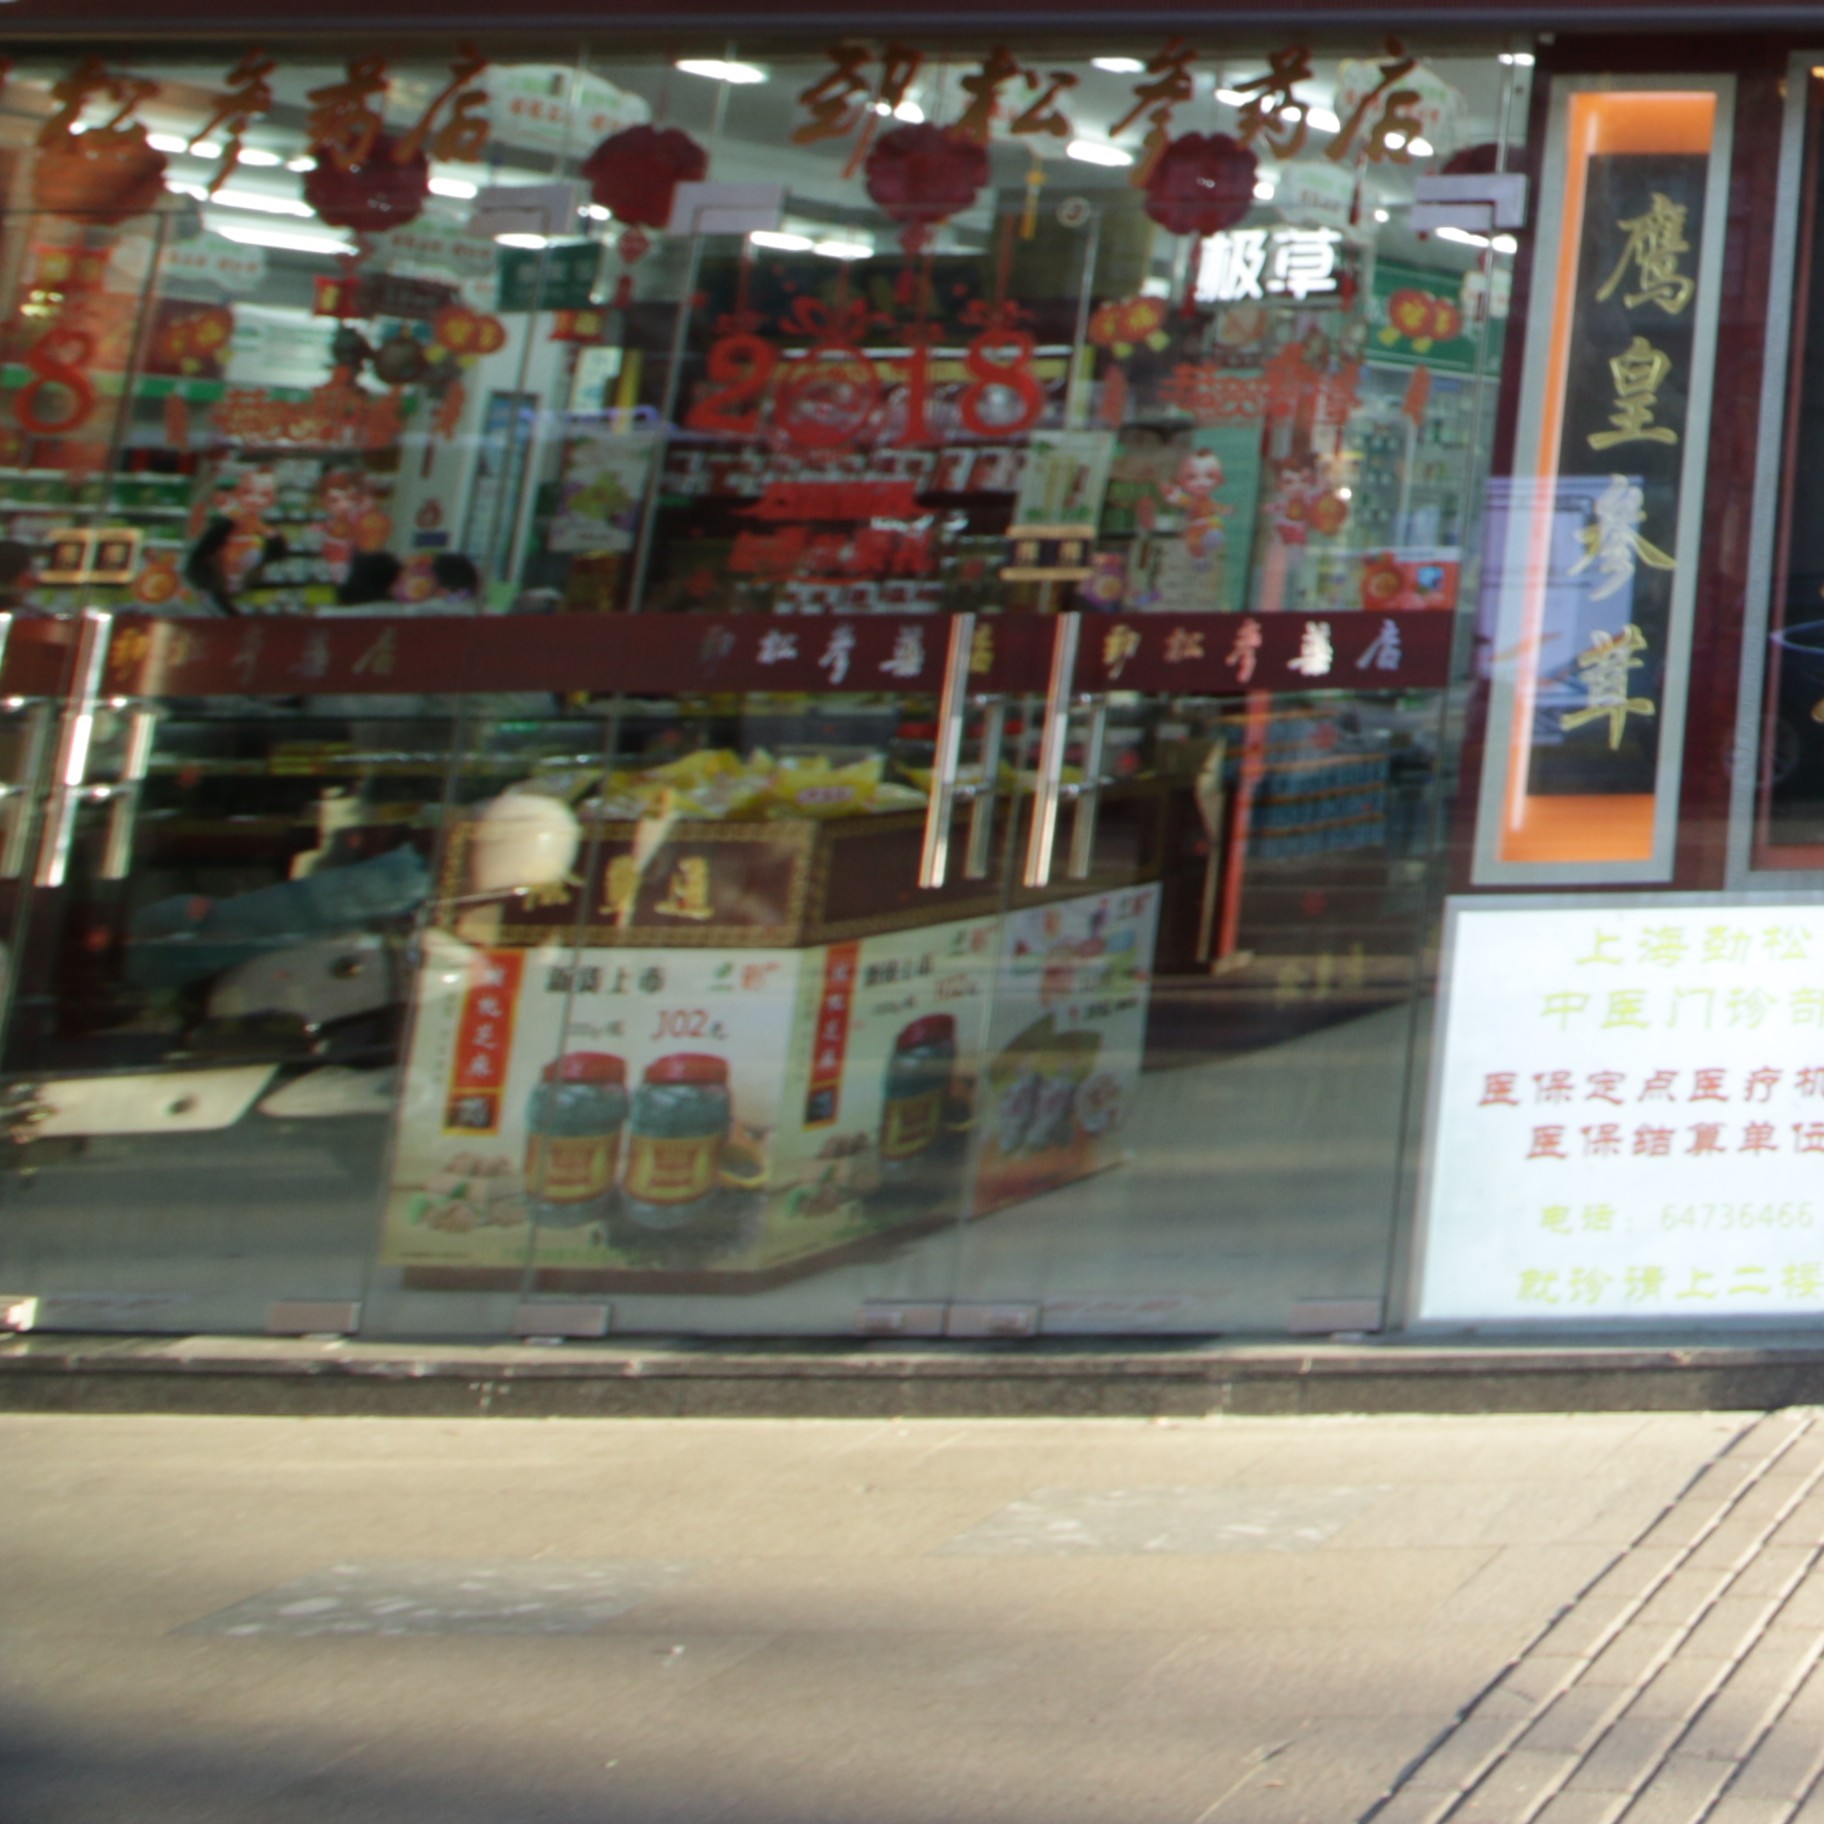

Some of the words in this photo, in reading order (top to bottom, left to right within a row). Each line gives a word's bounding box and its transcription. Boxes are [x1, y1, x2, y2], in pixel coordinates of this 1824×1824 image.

[1197, 229, 1341, 301] 极草
[1576, 925, 1813, 967] 上海劲松
[1517, 1262, 1824, 1304] 就诊请上二楼
